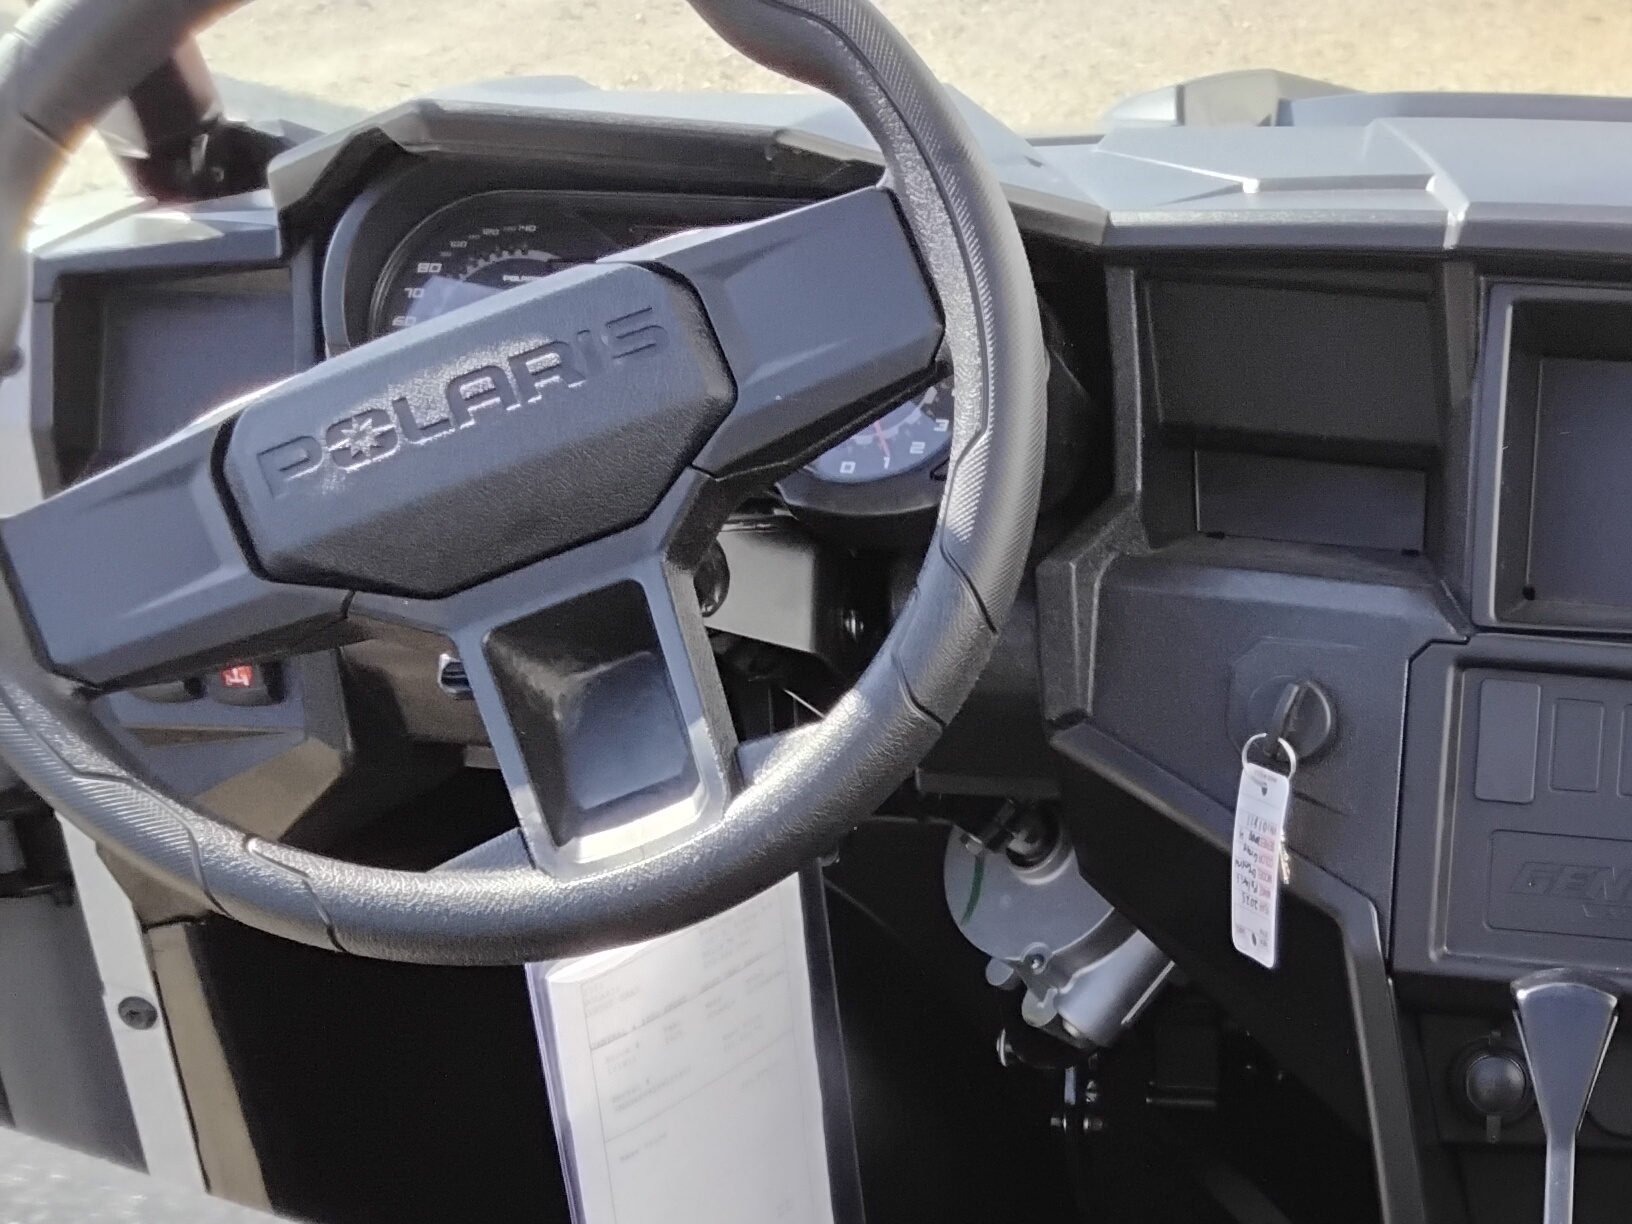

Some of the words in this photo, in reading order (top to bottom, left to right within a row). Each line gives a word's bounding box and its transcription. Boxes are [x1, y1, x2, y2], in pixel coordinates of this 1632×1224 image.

[417, 262, 442, 273] 80
[404, 287, 424, 298] 70
[392, 315, 416, 327] 60
[256, 305, 669, 500] POLARIS
[934, 418, 950, 432] 3
[909, 441, 926, 455] 2
[839, 461, 856, 474] 0
[883, 456, 891, 470] 1
